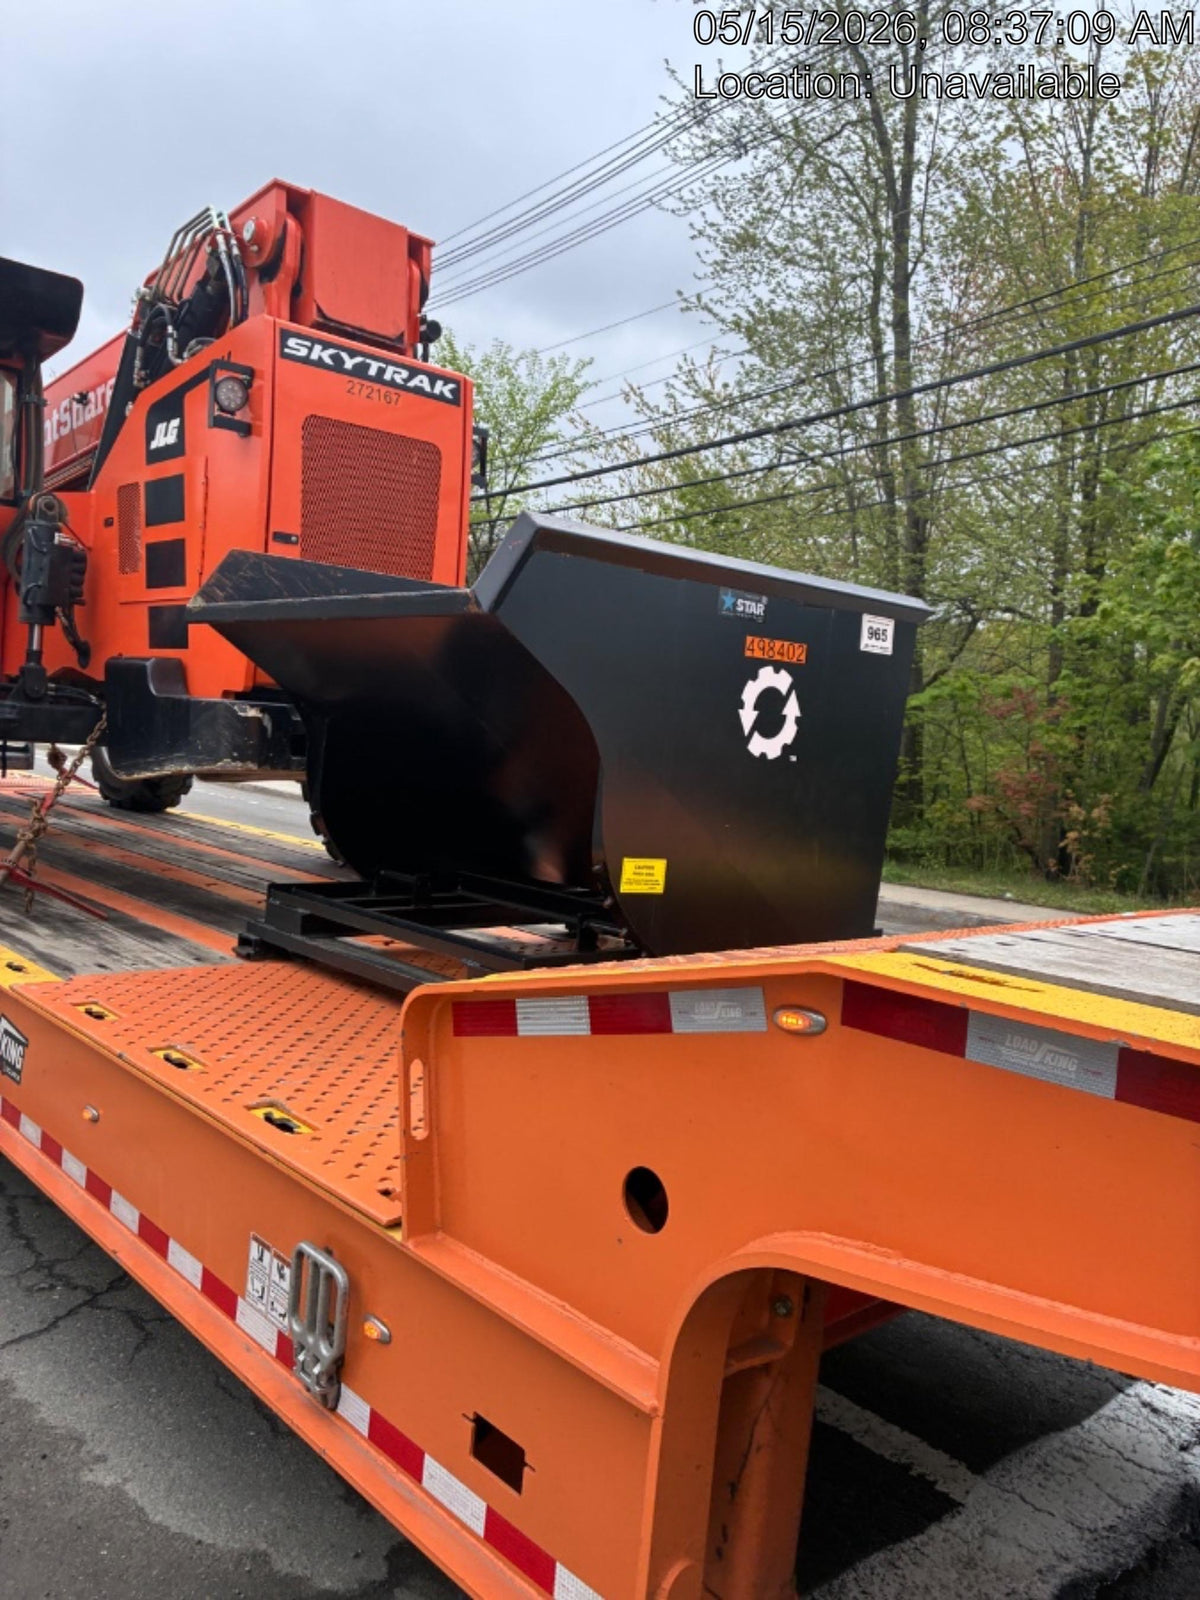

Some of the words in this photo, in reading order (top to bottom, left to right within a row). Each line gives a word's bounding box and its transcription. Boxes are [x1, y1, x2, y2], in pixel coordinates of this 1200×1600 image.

[283, 336, 458, 399] SKYTRAK
[346, 379, 401, 406] 272167
[149, 416, 180, 450] JLG
[735, 598, 765, 616] STAR
[866, 625, 888, 643] 965
[745, 637, 805, 662] 498402
[1043, 1051, 1079, 1072] KING
